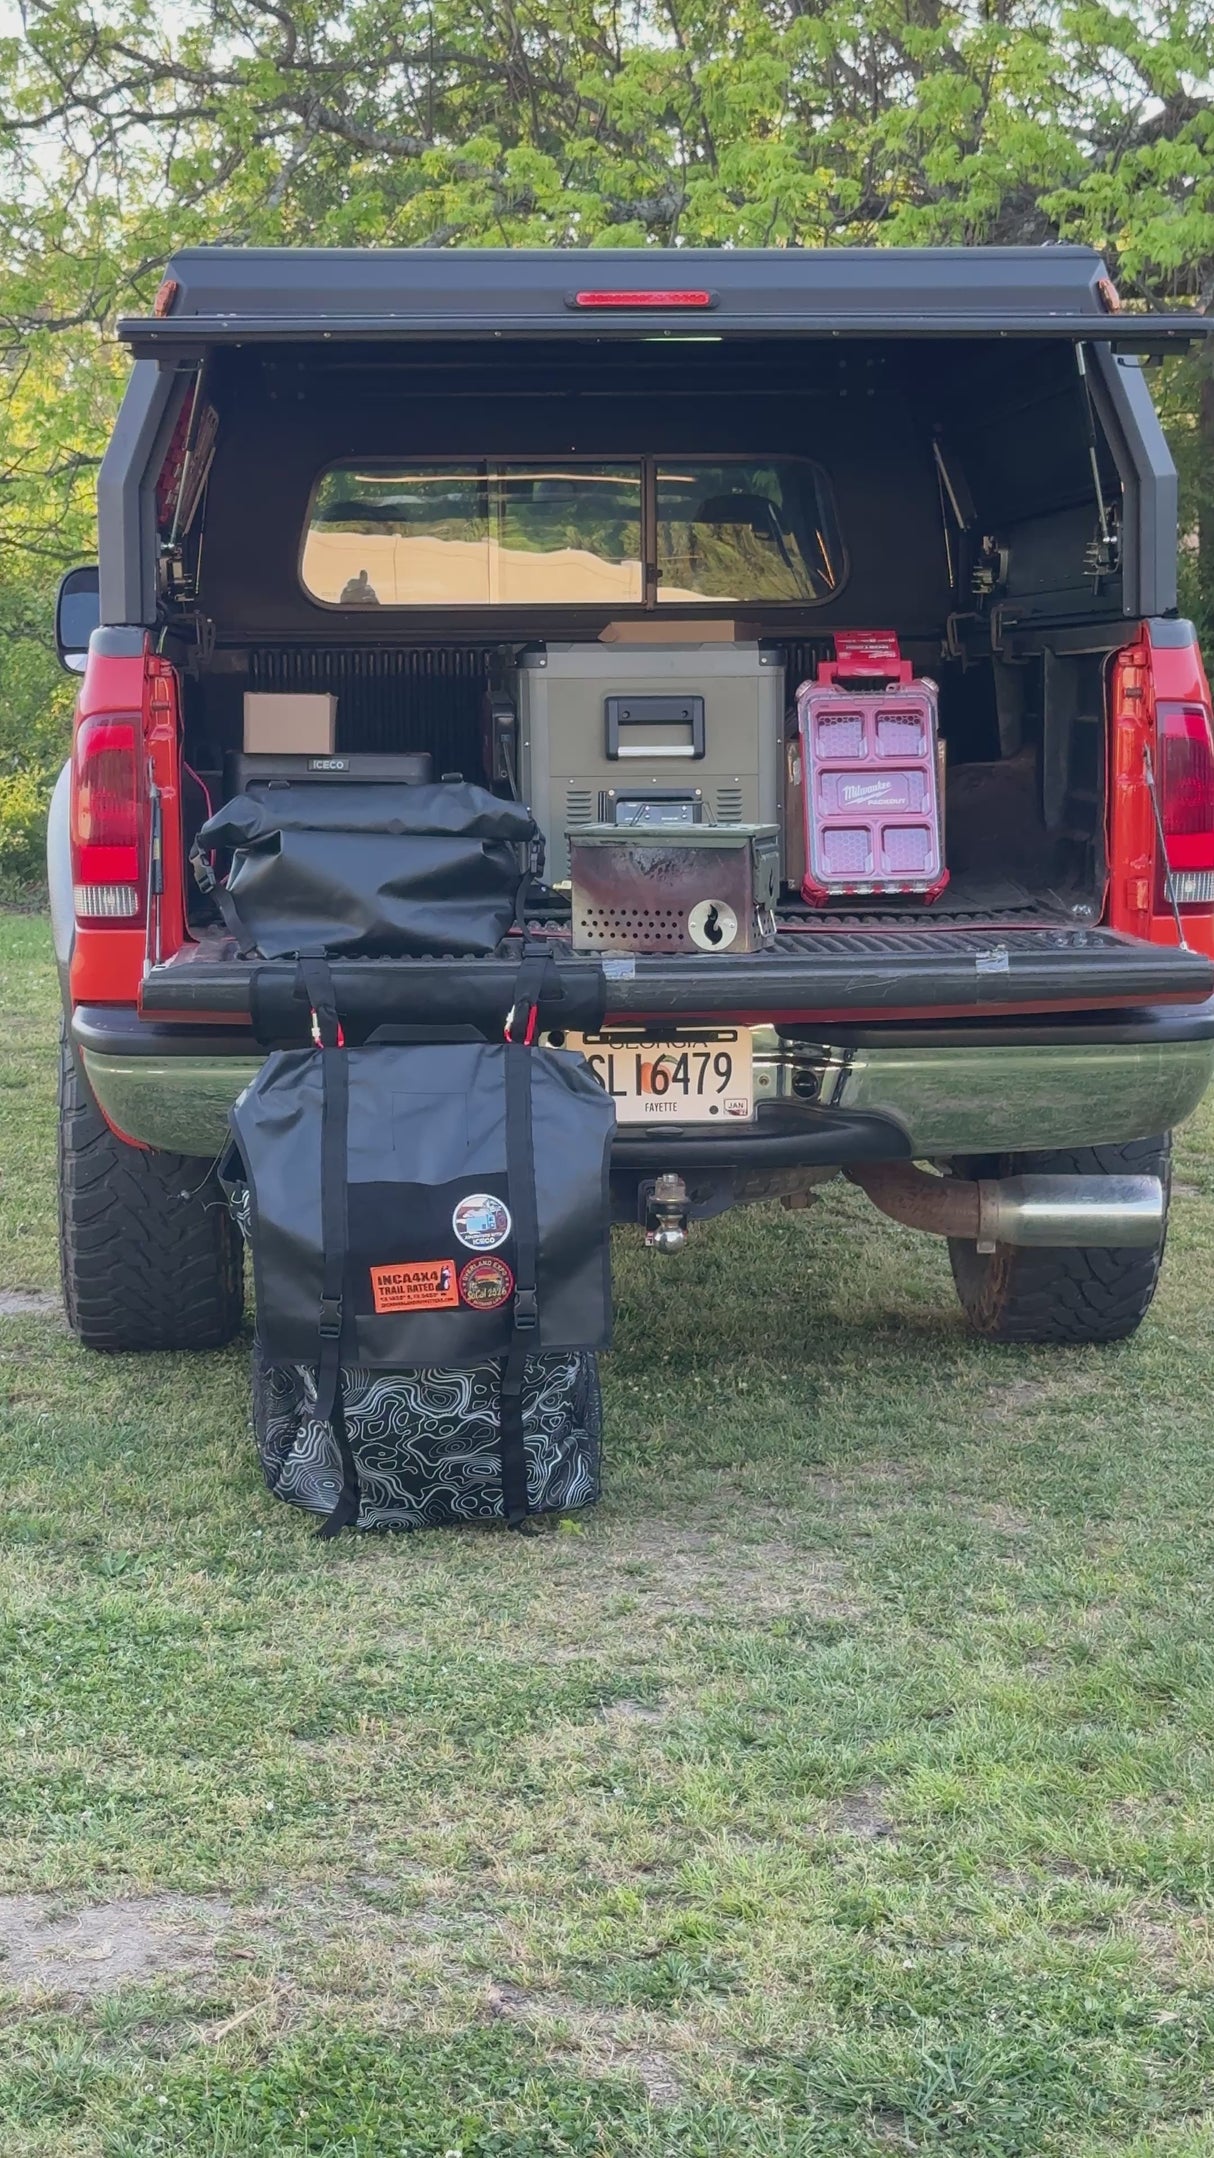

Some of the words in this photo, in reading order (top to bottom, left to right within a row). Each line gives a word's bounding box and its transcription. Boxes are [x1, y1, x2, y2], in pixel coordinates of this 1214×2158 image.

[313, 760, 344, 769] ICECO
[841, 780, 892, 801] Milwaukee
[644, 1102, 678, 1112] FAYETTE
[462, 1260, 492, 1280] OVERLAND
[492, 1261, 508, 1276] EXPO
[377, 1271, 439, 1286] INCA4X4
[378, 1285, 405, 1296] TRAIL
[407, 1282, 435, 1294] RATED
